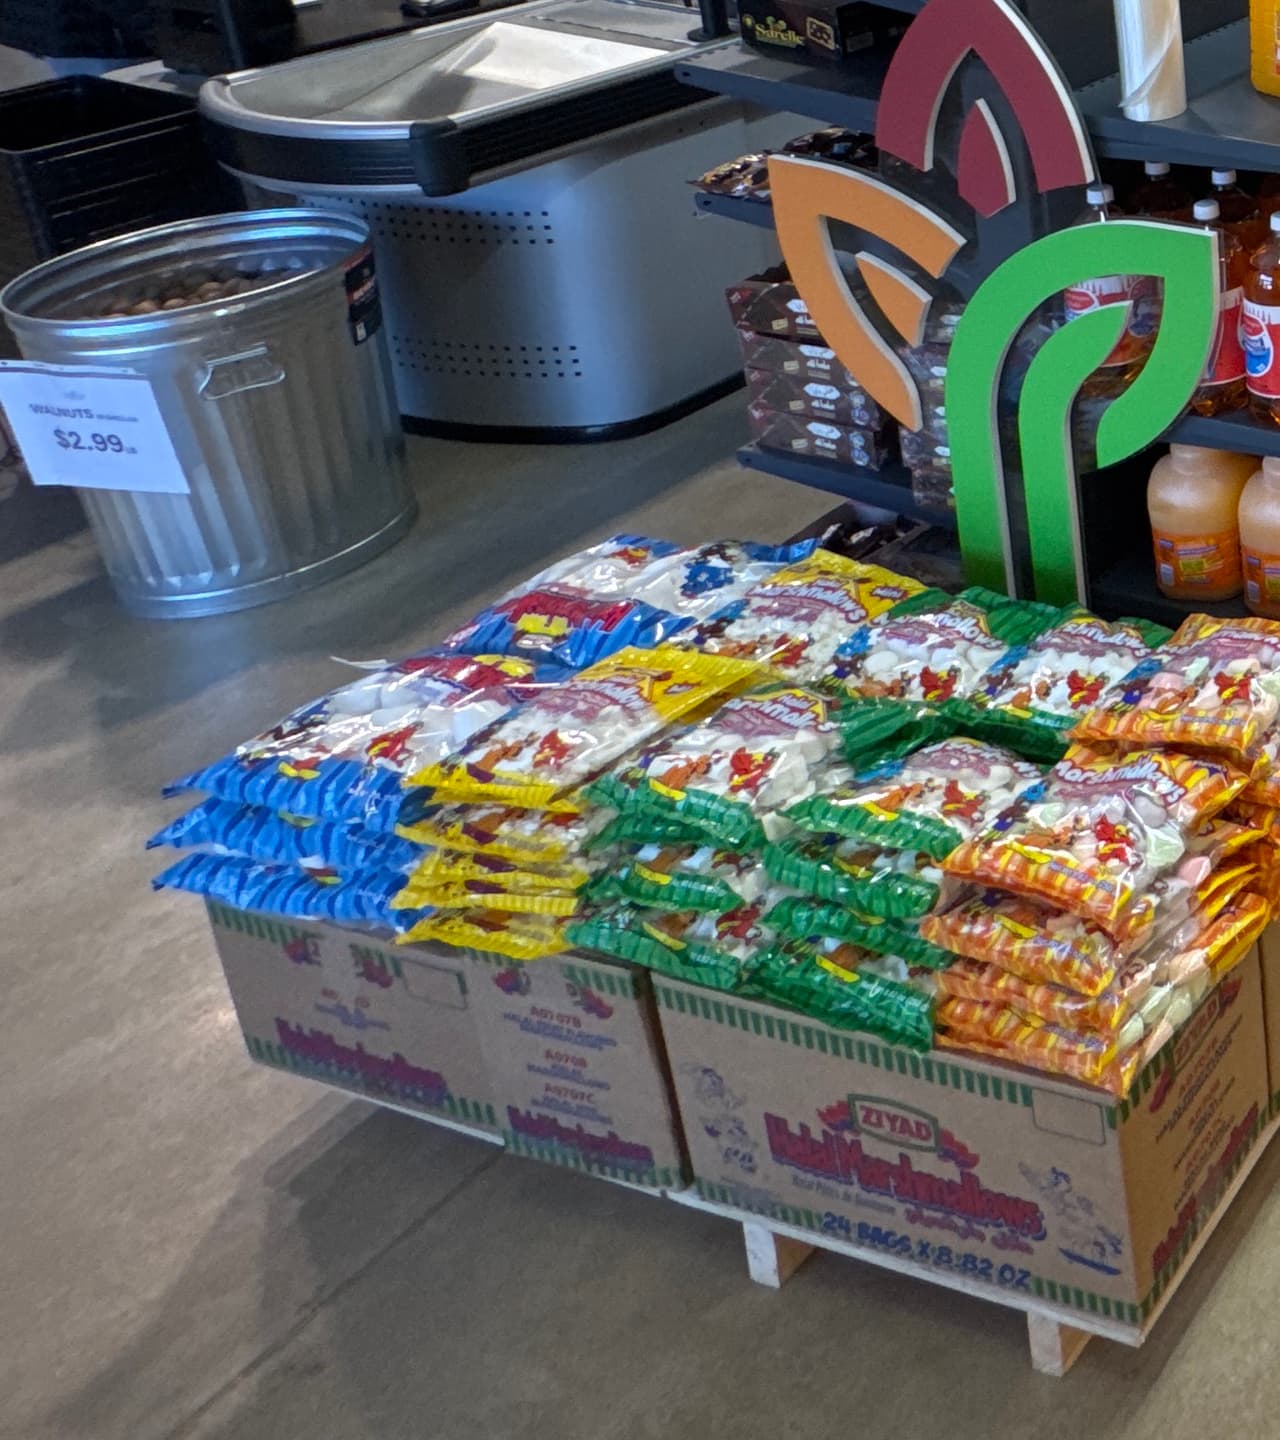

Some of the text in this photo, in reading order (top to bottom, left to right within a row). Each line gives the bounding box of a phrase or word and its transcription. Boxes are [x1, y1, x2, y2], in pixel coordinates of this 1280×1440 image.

[28, 403, 94, 420] WALNUTS
[53, 426, 124, 453] $2.99
[1053, 752, 1189, 805] Marshmallows
[859, 1105, 932, 1142] ZIYAD
[764, 1112, 838, 1180] Halal
[837, 1134, 1048, 1242] Marshmallows
[823, 1212, 850, 1234] 24
[857, 1222, 912, 1254] BAGS
[918, 1239, 932, 1260] X
[999, 1262, 1032, 1288] OZ
